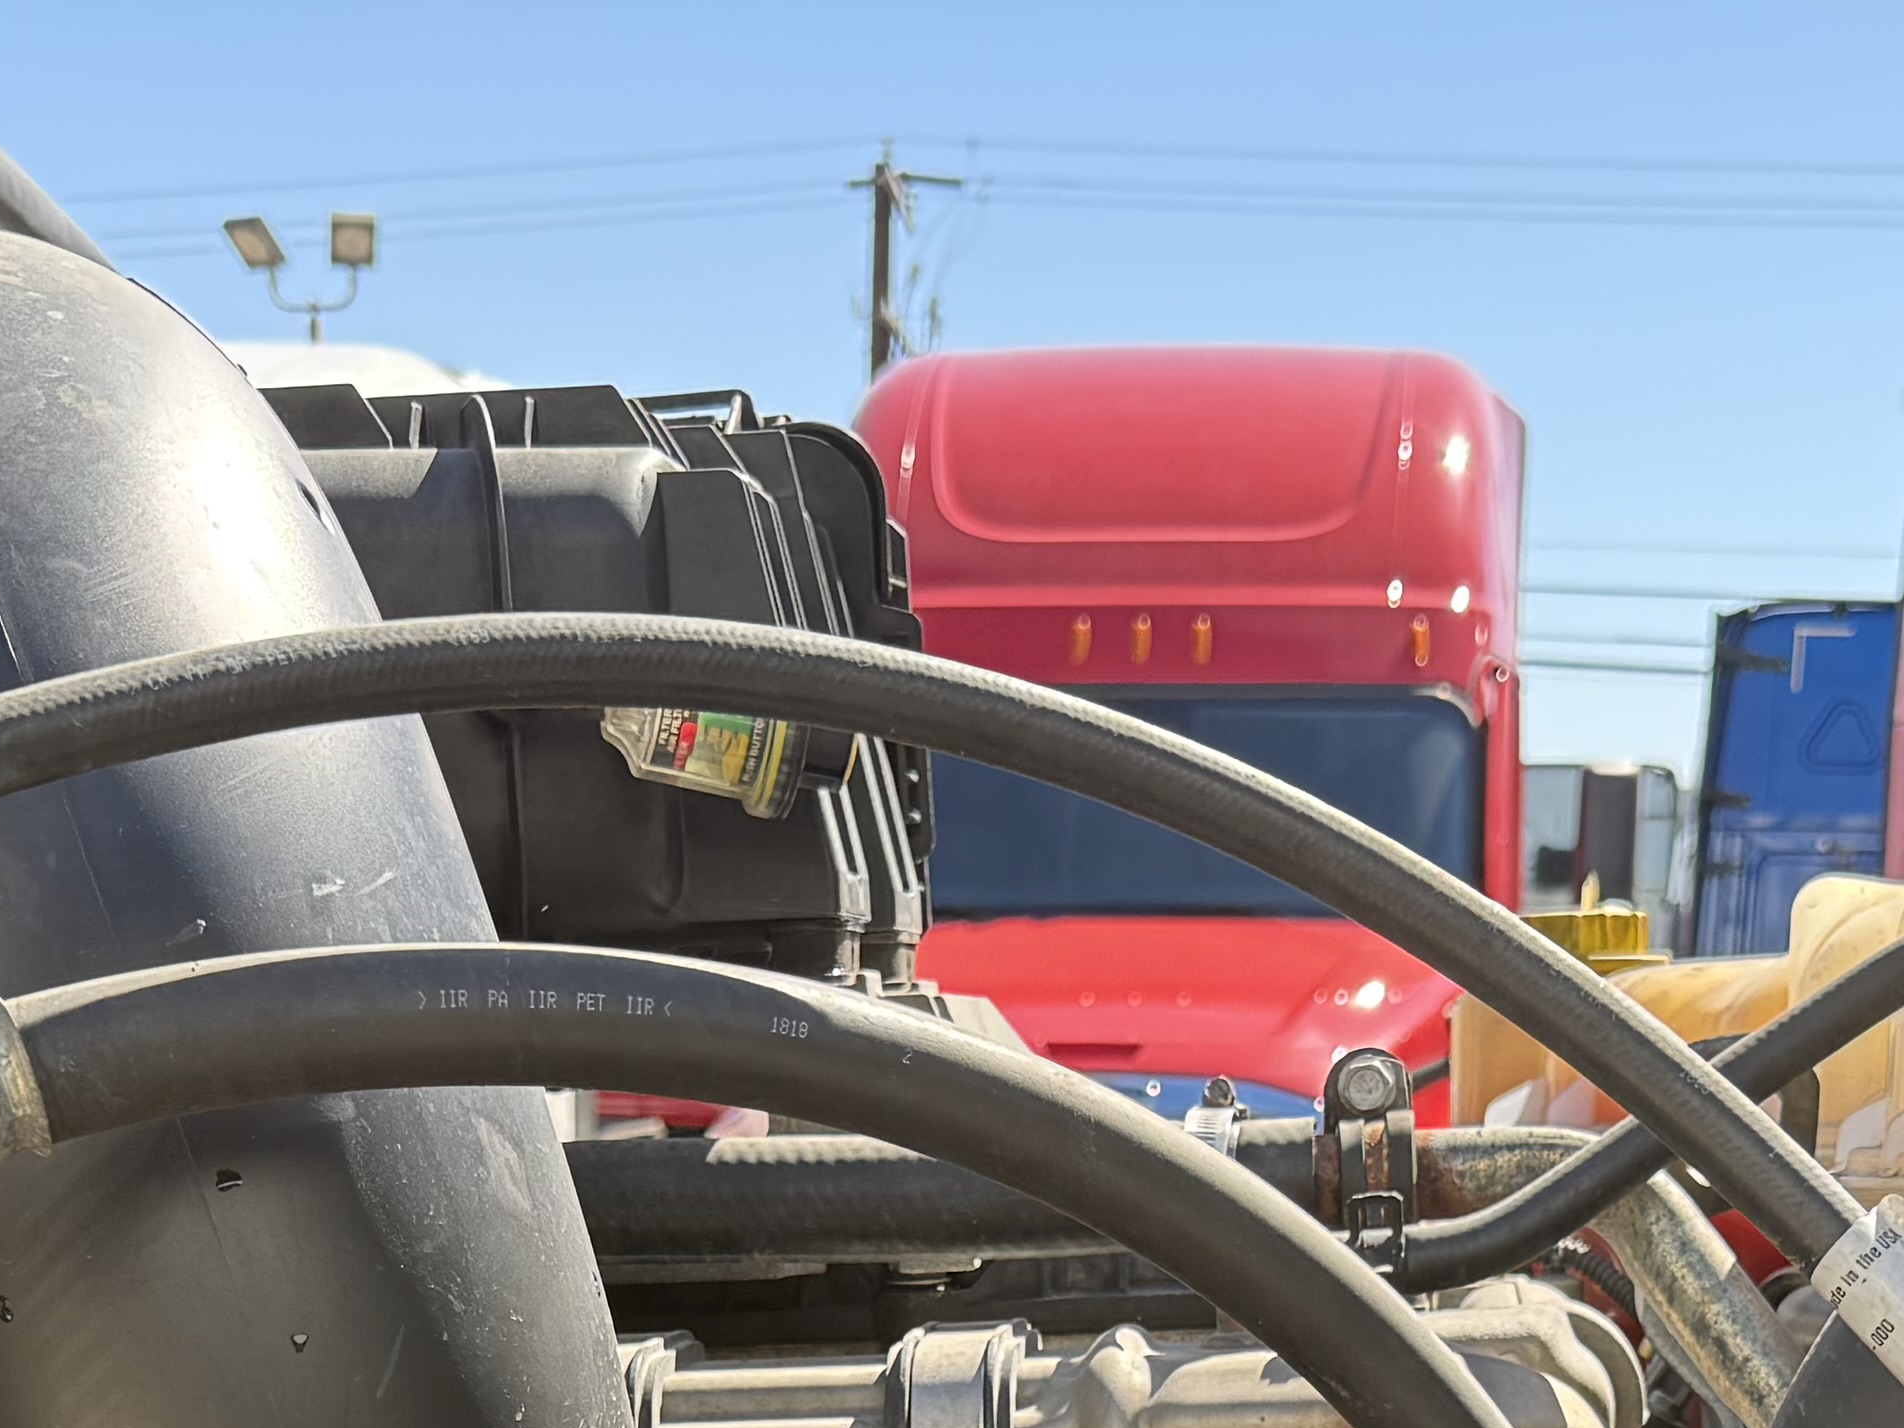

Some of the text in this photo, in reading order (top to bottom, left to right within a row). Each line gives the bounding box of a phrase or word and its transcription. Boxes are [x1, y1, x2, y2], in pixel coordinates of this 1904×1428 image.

[576, 992, 607, 1013] PET
[770, 1015, 810, 1040] 1818
[1875, 1226, 1903, 1251] USA
